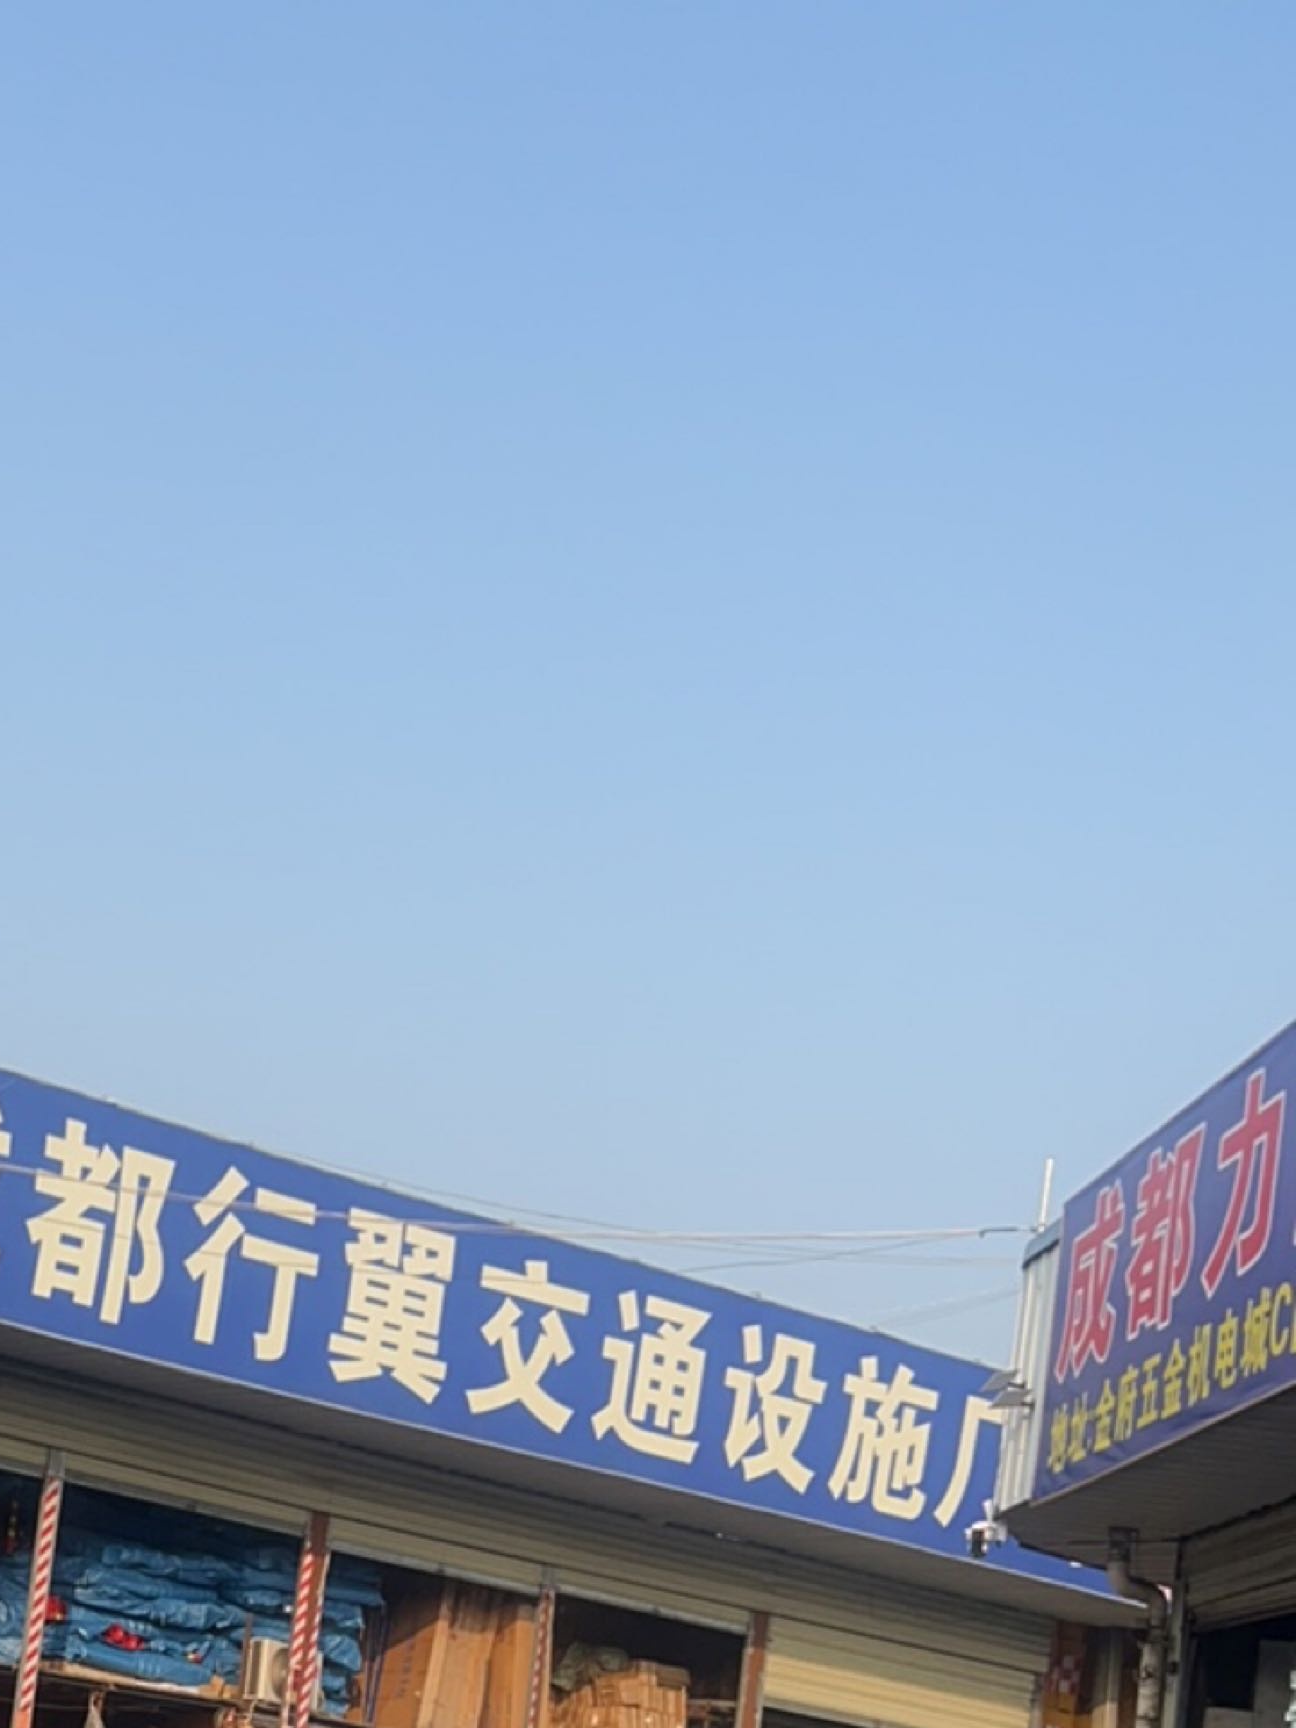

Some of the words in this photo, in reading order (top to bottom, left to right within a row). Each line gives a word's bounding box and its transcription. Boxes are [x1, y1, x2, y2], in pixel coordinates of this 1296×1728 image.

[1054, 1066, 1296, 1384] 成都力
[1046, 1281, 1296, 1475] 地址：金府五金机电城C
